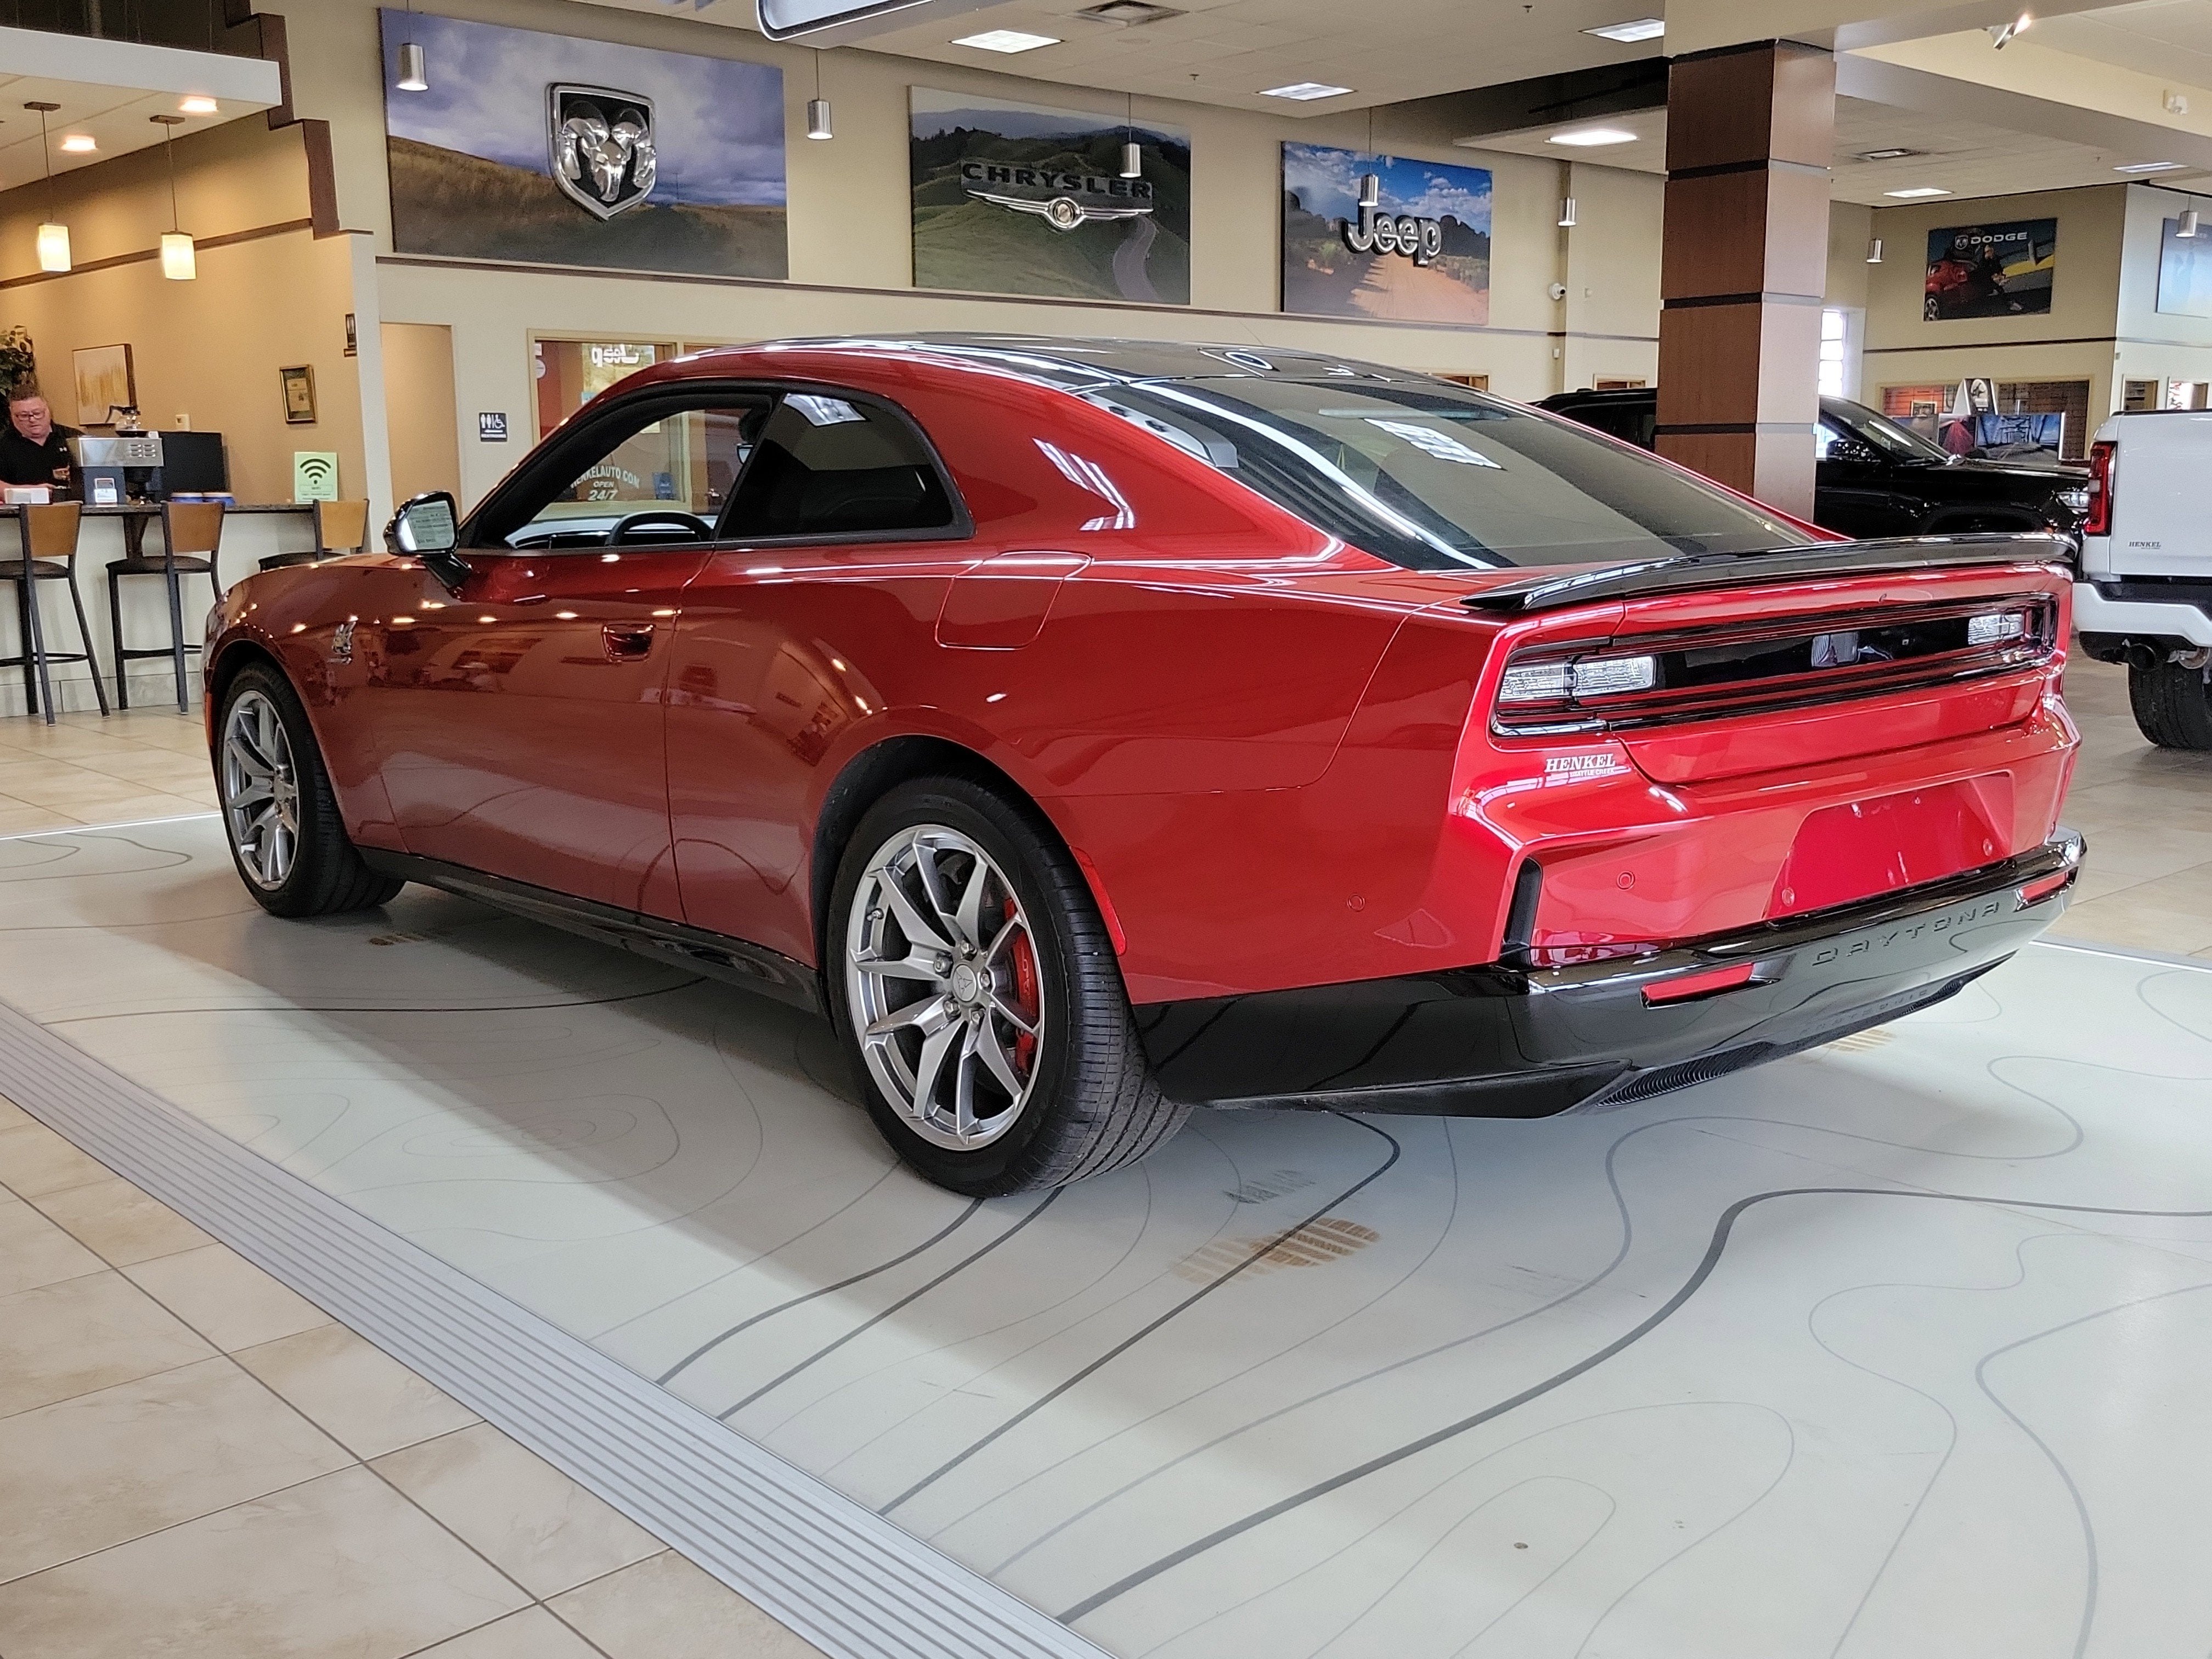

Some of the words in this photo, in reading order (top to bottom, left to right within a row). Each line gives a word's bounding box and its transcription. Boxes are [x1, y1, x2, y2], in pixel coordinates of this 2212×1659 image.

[962, 162, 1151, 198] CHRYSLER
[1343, 205, 1442, 267] Jeep
[1970, 232, 2028, 245] DODGE
[588, 489, 618, 501] 24/7
[1544, 753, 1616, 772] HENKEL
[1812, 900, 2000, 966] DAYTONA
